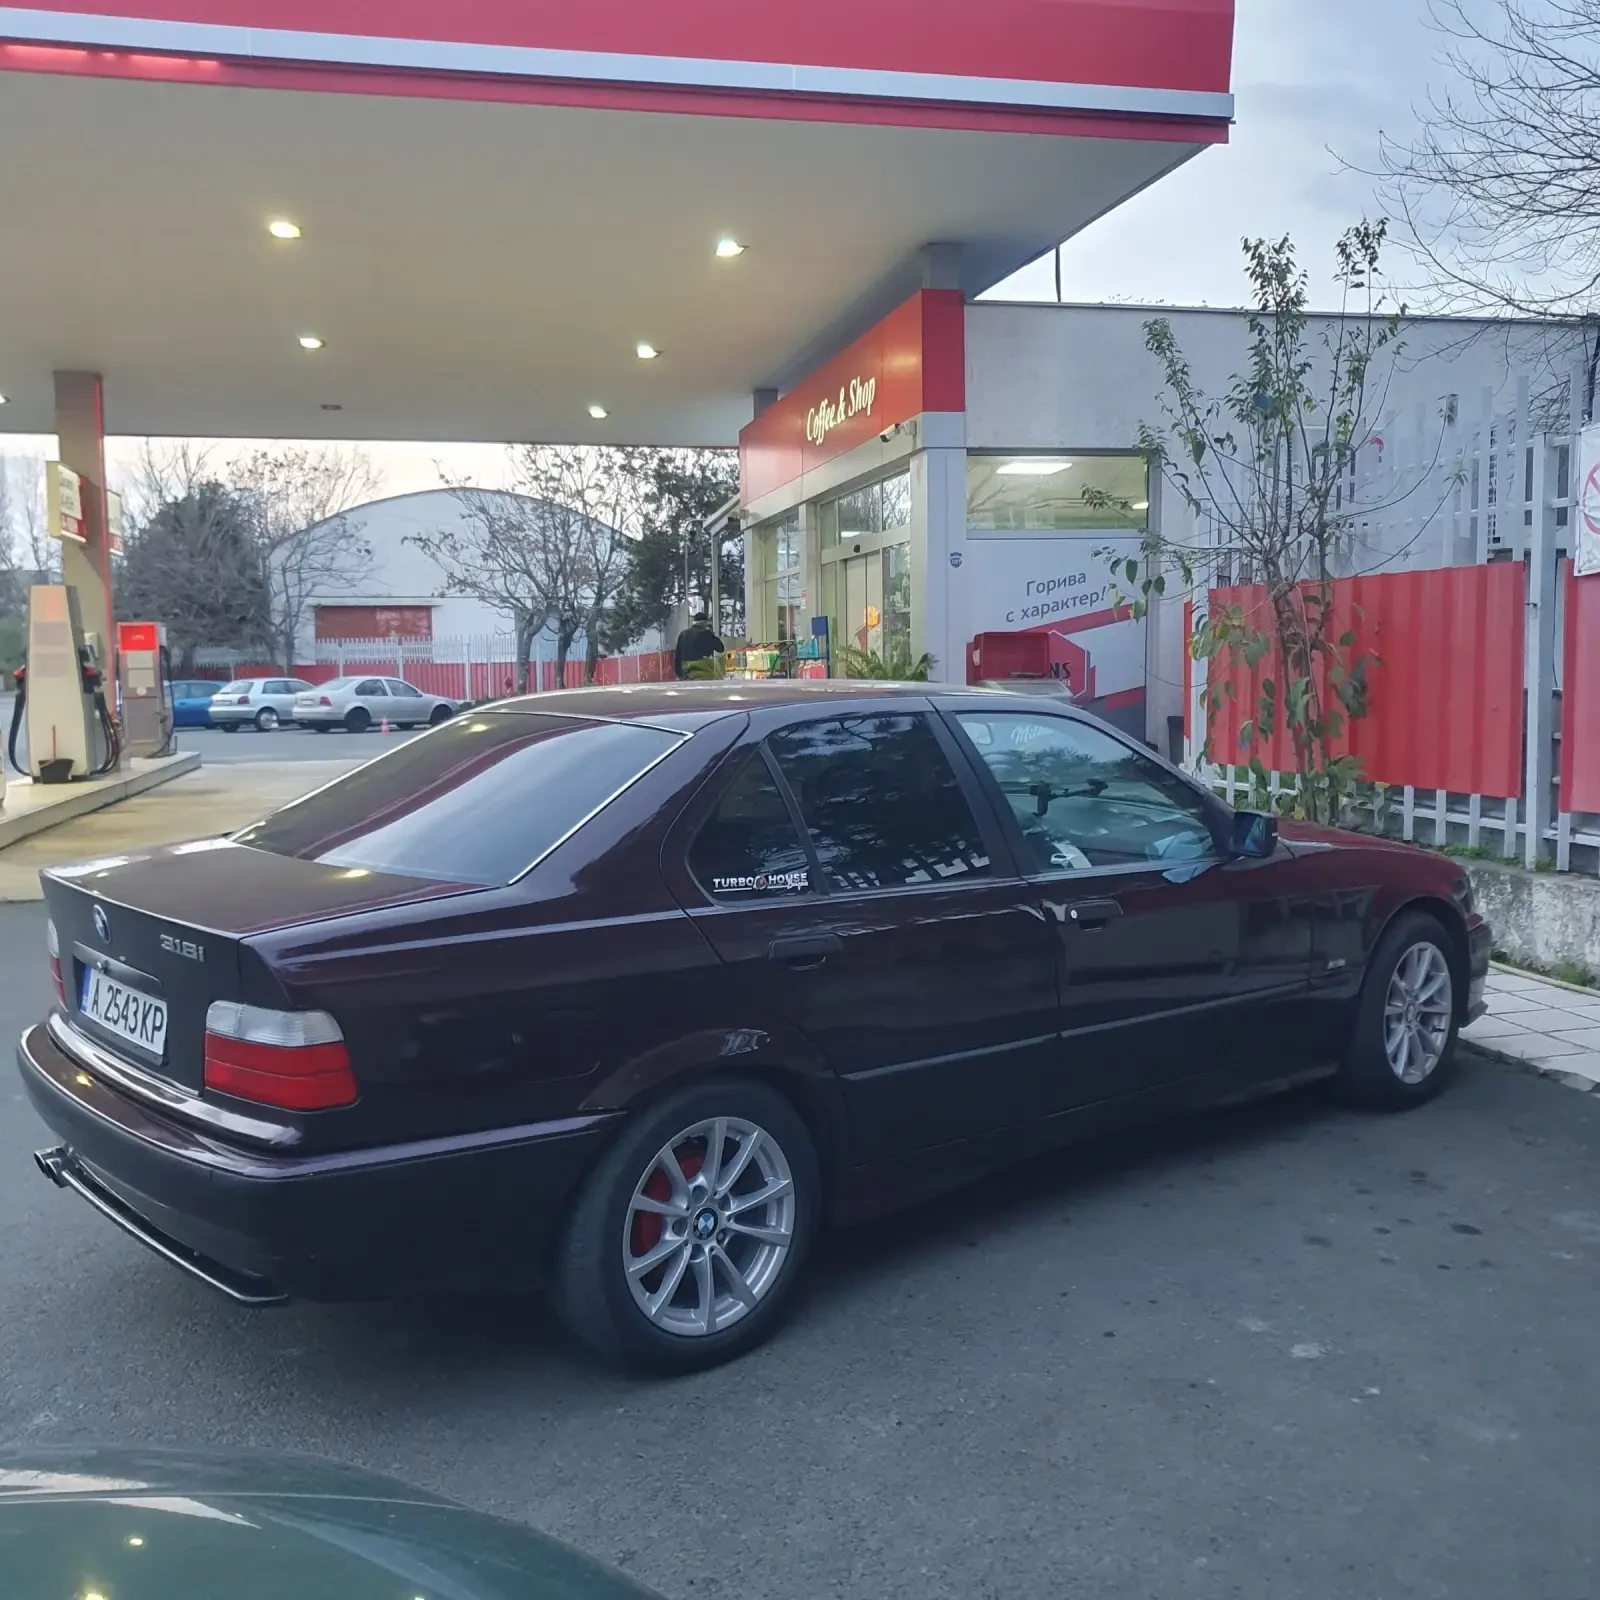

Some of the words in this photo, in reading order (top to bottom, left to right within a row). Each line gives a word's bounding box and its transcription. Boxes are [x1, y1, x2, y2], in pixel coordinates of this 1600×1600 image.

[807, 398, 836, 446] Coffee
[837, 387, 846, 424] &
[848, 376, 876, 416] Shop
[1026, 572, 1087, 597] Горива
[1005, 611, 1015, 623] с
[1020, 585, 1107, 620] характер!
[1049, 661, 1073, 680] NS
[713, 877, 754, 889] TURBO
[768, 872, 808, 885] HOUSE
[160, 934, 204, 963] 318i
